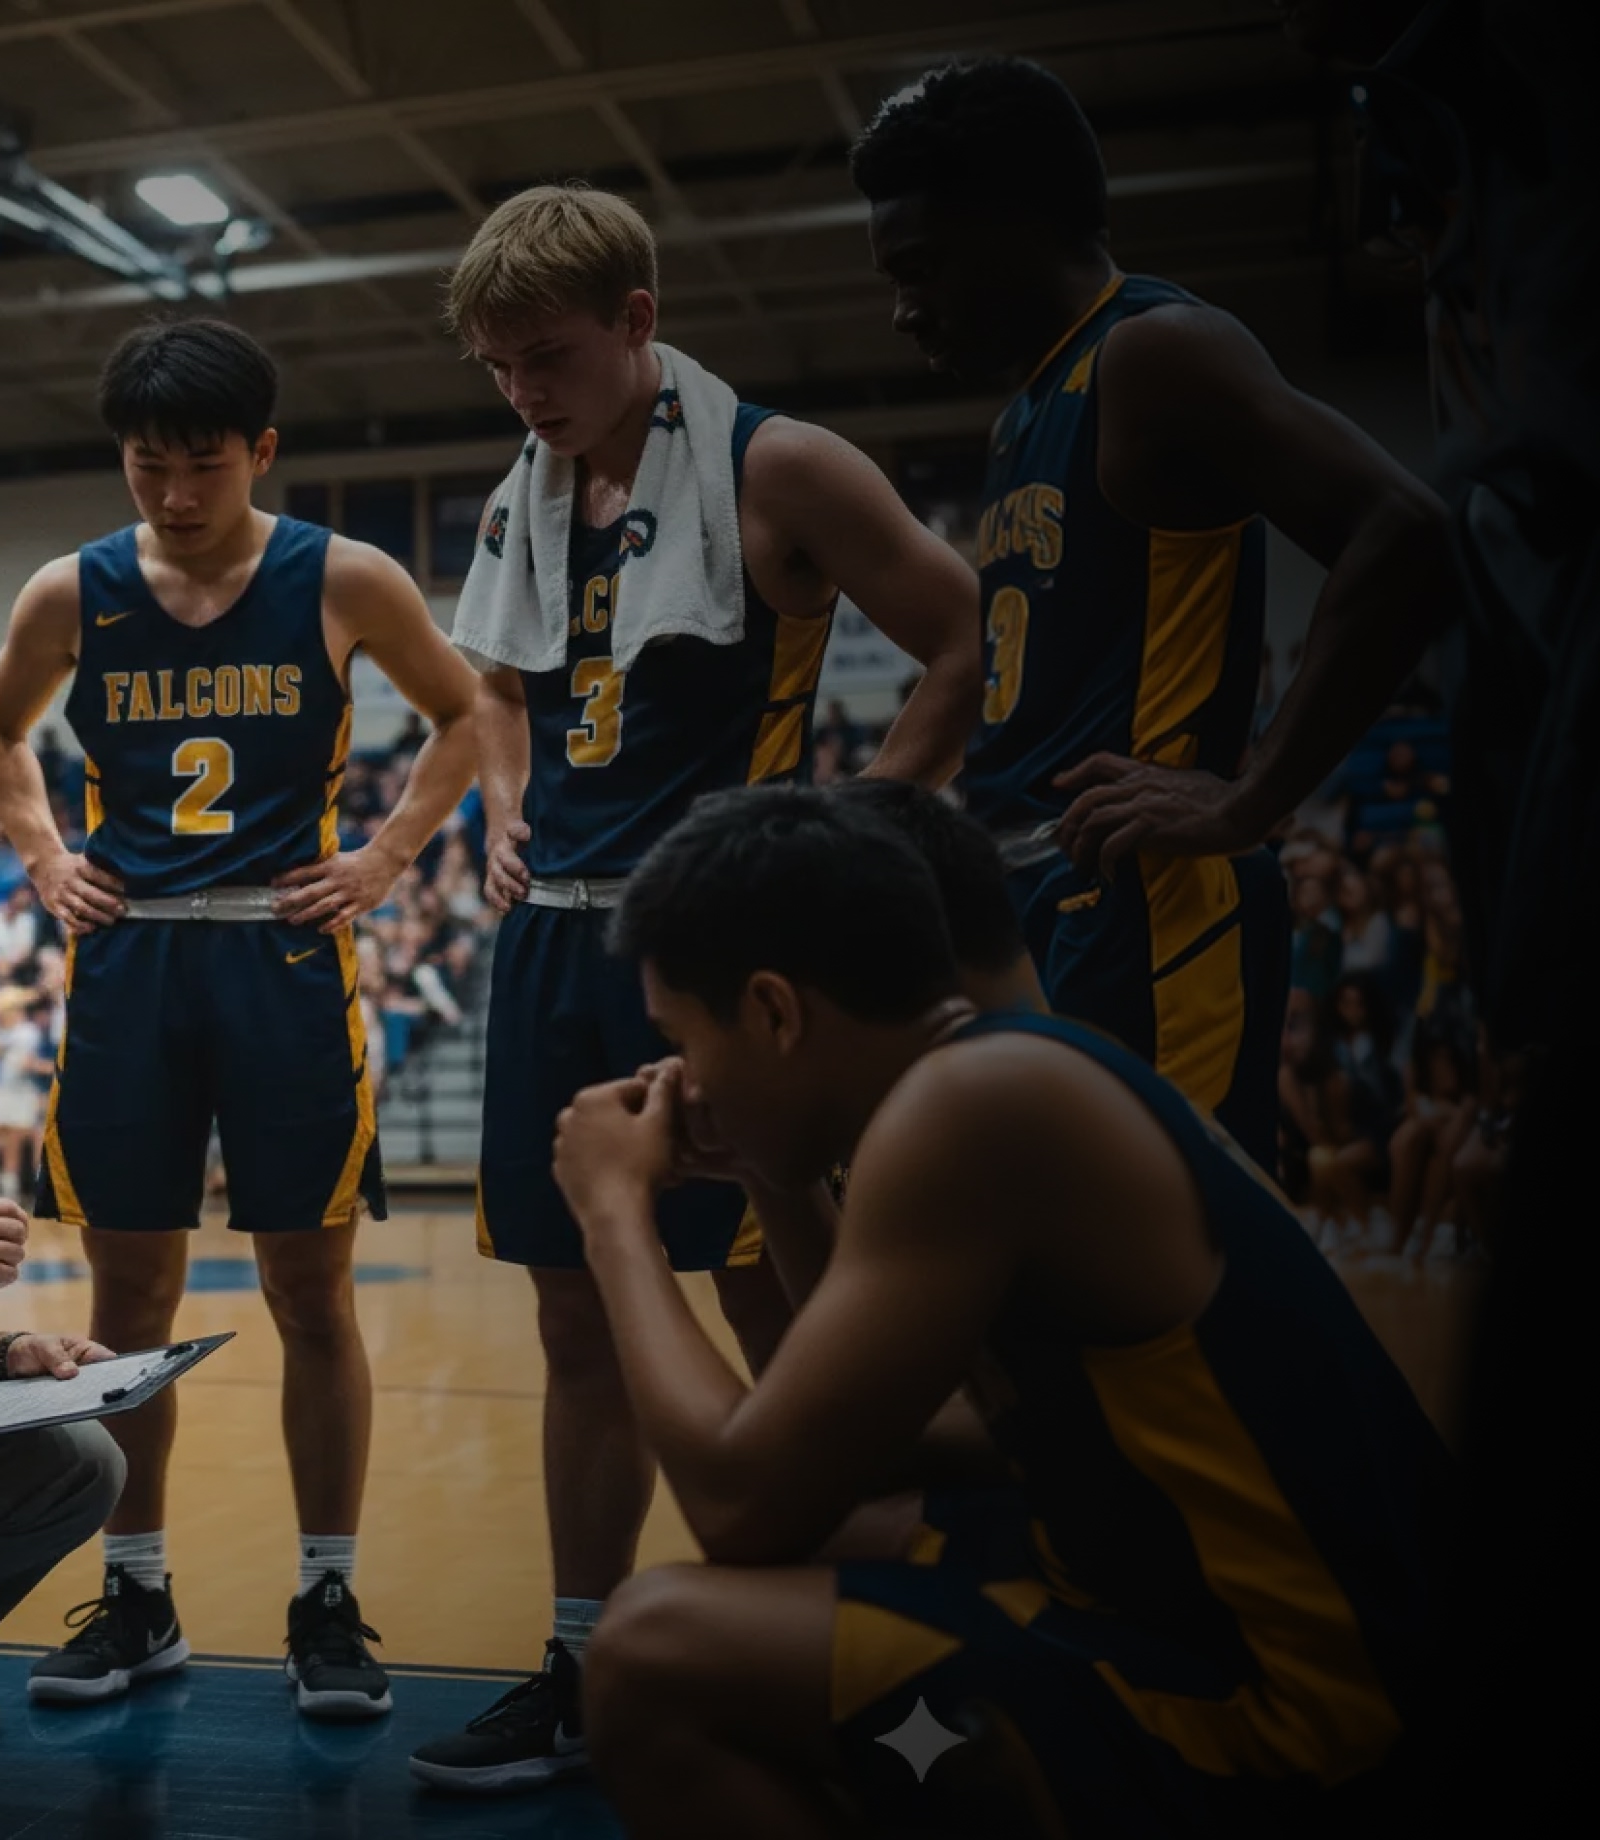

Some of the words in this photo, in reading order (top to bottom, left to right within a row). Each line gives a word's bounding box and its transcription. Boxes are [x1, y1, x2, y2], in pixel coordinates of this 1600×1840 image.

[102, 664, 303, 723] FALCONS
[566, 655, 627, 768] 3
[171, 736, 235, 835] 2
